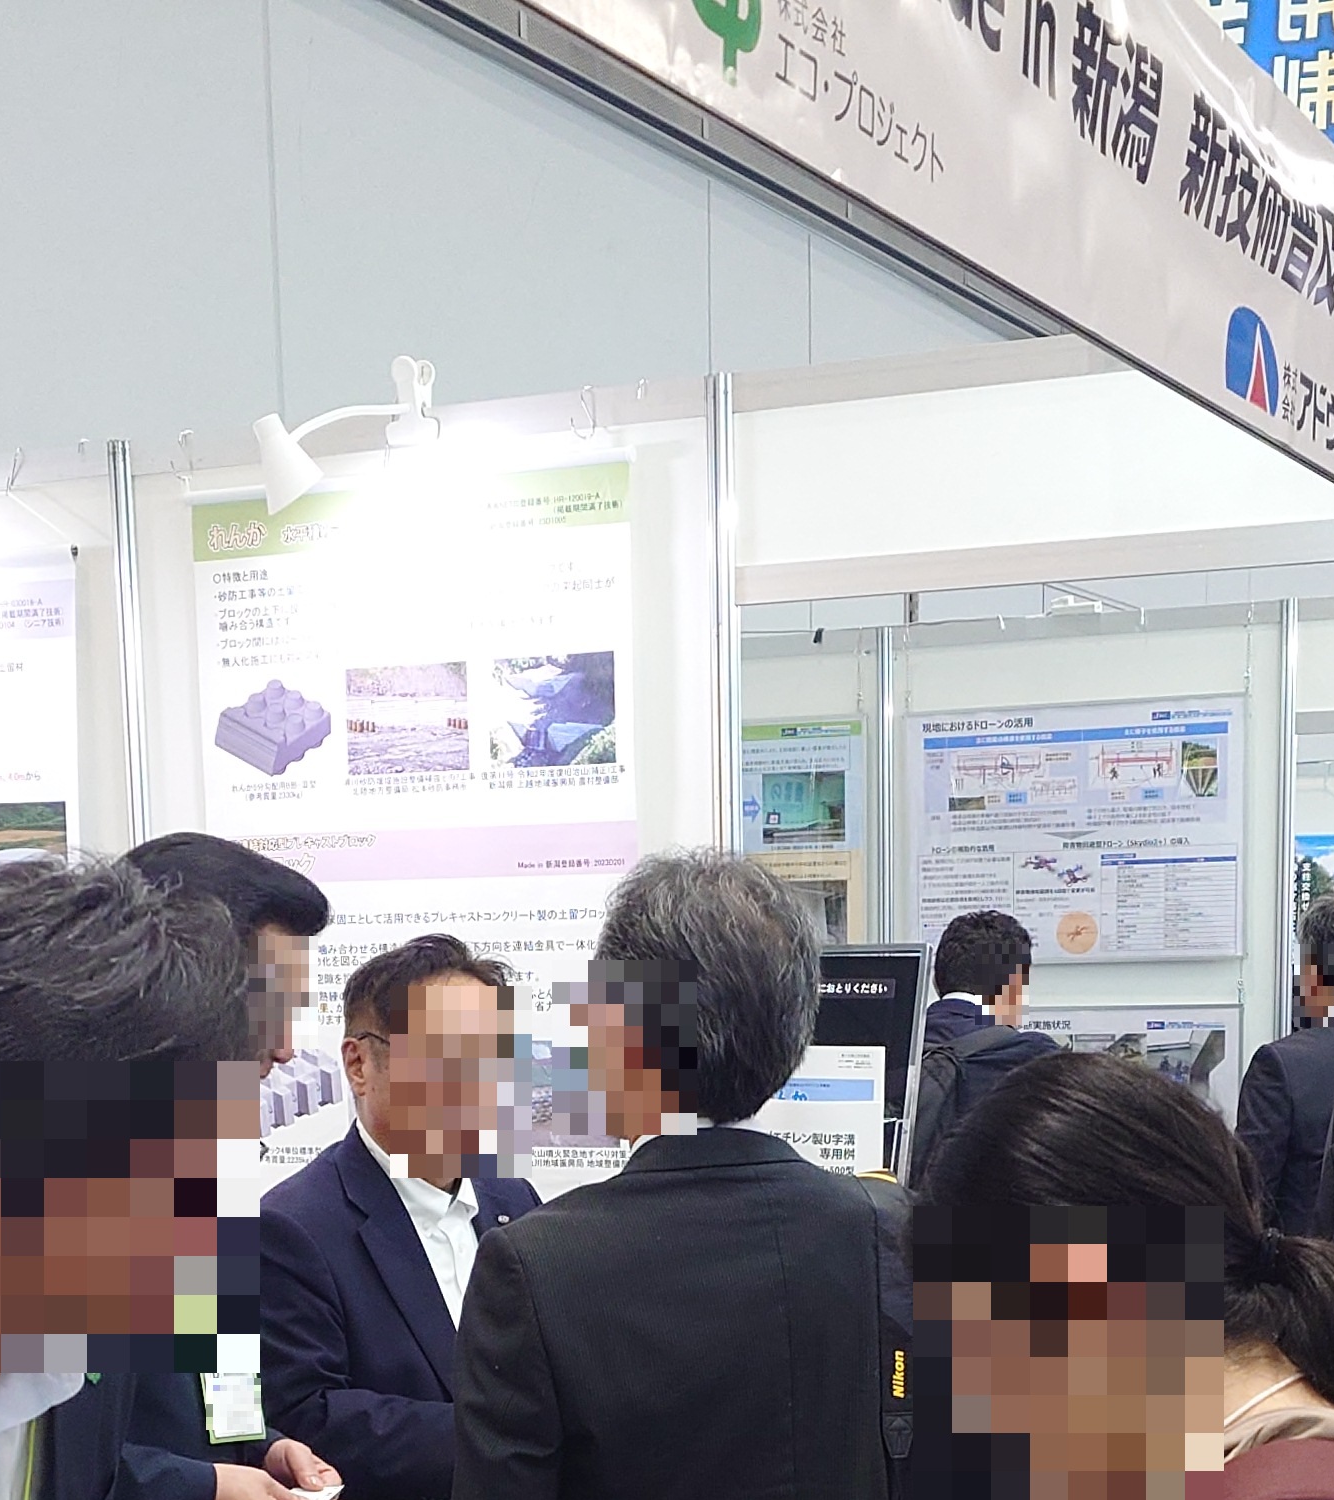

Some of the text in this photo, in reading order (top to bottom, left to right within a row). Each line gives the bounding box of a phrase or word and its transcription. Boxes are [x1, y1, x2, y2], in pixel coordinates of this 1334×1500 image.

[775, 34, 944, 182] エコ・プロジェクト
[1071, 17, 1164, 186] 新潟
[209, 522, 267, 551] れんか
[923, 717, 1034, 733] 現地におけるドローンの活用
[818, 983, 888, 993] におとりください
[819, 1148, 855, 1161] 専用桝
[892, 1350, 905, 1399] Nikon
